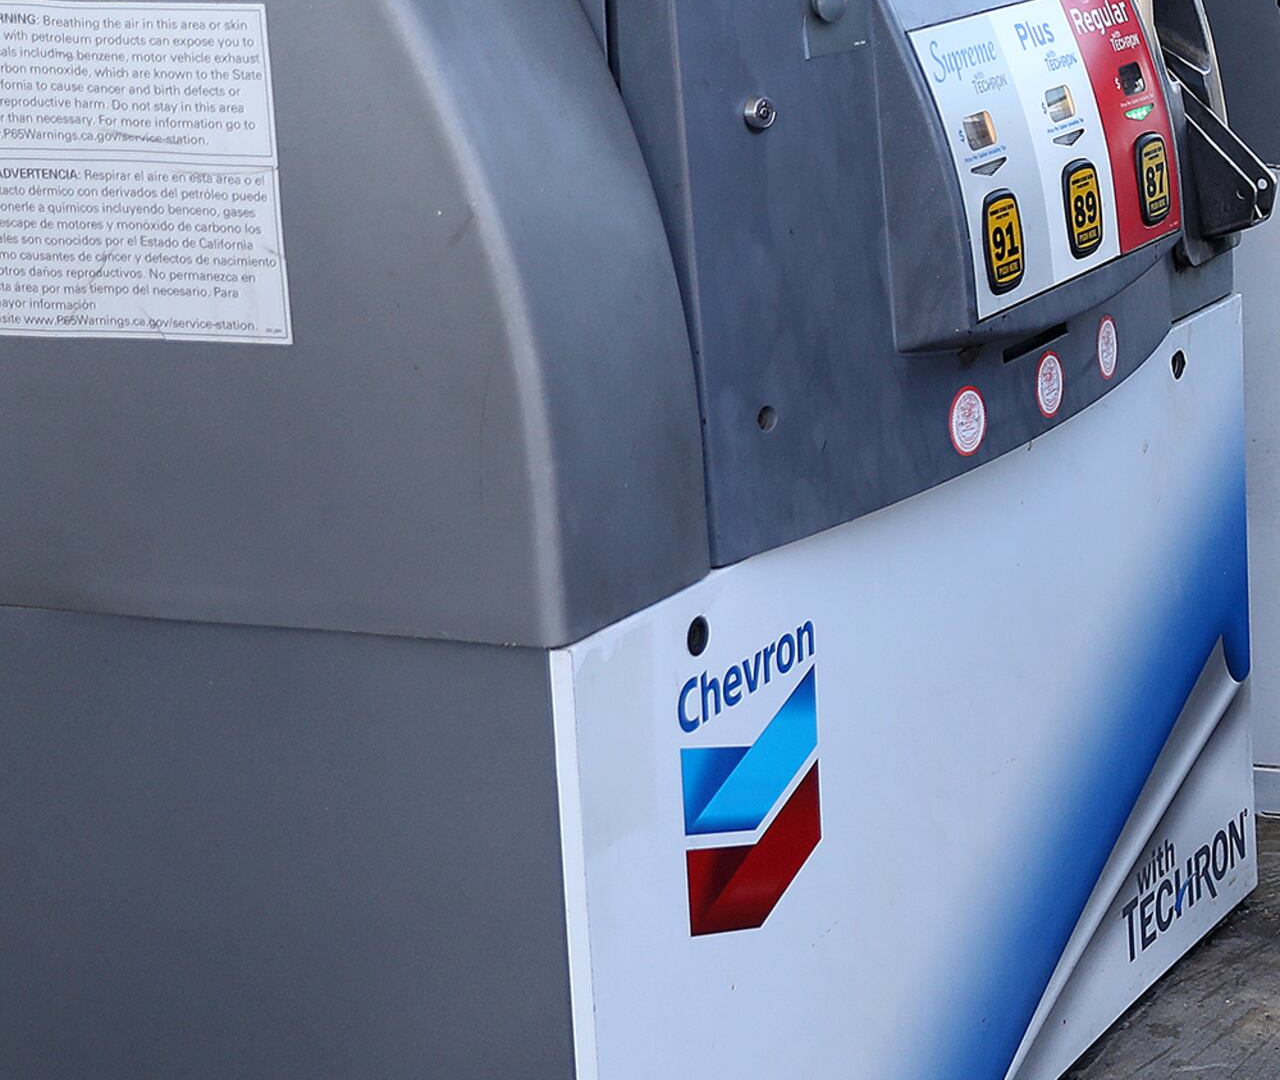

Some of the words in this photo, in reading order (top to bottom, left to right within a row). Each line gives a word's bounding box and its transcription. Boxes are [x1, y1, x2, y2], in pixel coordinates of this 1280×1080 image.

[43, 15, 100, 30] Breathing
[103, 18, 121, 29] the
[125, 19, 139, 29] air
[143, 19, 153, 29] in
[157, 19, 177, 30] this
[181, 21, 206, 30] area
[209, 22, 221, 30] or
[225, 20, 247, 31] skin
[1069, 0, 1129, 35] Regular
[4, 30, 27, 41] with
[32, 33, 91, 44] petroleum
[96, 35, 146, 47] products
[150, 37, 169, 46] can
[173, 39, 214, 49] expose
[218, 39, 239, 49] you
[243, 37, 254, 47] to
[1014, 21, 1055, 50] Plus
[0, 46, 17, 58] als
[20, 47, 73, 61] including
[77, 50, 128, 63] benzene,
[132, 53, 167, 63] motor
[171, 52, 210, 64] vehicle
[214, 54, 260, 64] exhaust
[929, 40, 998, 83] Supreme
[30, 65, 91, 77] monoxide,
[95, 67, 129, 78] which
[132, 70, 150, 79] are
[154, 68, 192, 80] known
[196, 70, 207, 80] to
[211, 69, 229, 80] the
[232, 69, 262, 80] State
[36, 80, 47, 91] to
[51, 83, 83, 92] cause
[87, 85, 125, 95] cancer
[129, 84, 150, 95] and
[154, 84, 180, 96] birth
[184, 85, 225, 97] defects
[228, 88, 240, 97] or
[75, 97, 108, 109] harm.
[112, 99, 128, 111] Do
[132, 101, 150, 111] not
[154, 101, 178, 113] stay
[181, 101, 192, 112] in
[195, 101, 216, 112] this
[219, 103, 244, 113] area
[8, 112, 33, 123] than
[36, 114, 95, 126] necessary.
[99, 115, 117, 126] For
[121, 118, 151, 128] more
[155, 117, 222, 129] information
[226, 120, 241, 132] go
[244, 119, 255, 130] to
[1146, 161, 1164, 198] 87
[28, 184, 74, 197] dérmico
[77, 187, 98, 197] con
[101, 186, 158, 198] derivados
[160, 187, 178, 199] del
[181, 188, 229, 201] petróleo
[232, 190, 268, 203] puede
[1074, 190, 1097, 228] 89
[21, 236, 42, 246] son
[44, 234, 102, 247] conocidos
[105, 237, 124, 248] por
[127, 236, 137, 246] el
[140, 236, 179, 248] Estado
[182, 237, 196, 249] de
[199, 237, 253, 251] California
[992, 221, 1020, 261] 91
[677, 620, 816, 733] Chevron
[1136, 839, 1176, 896] with
[1122, 813, 1246, 963] TECHRON
